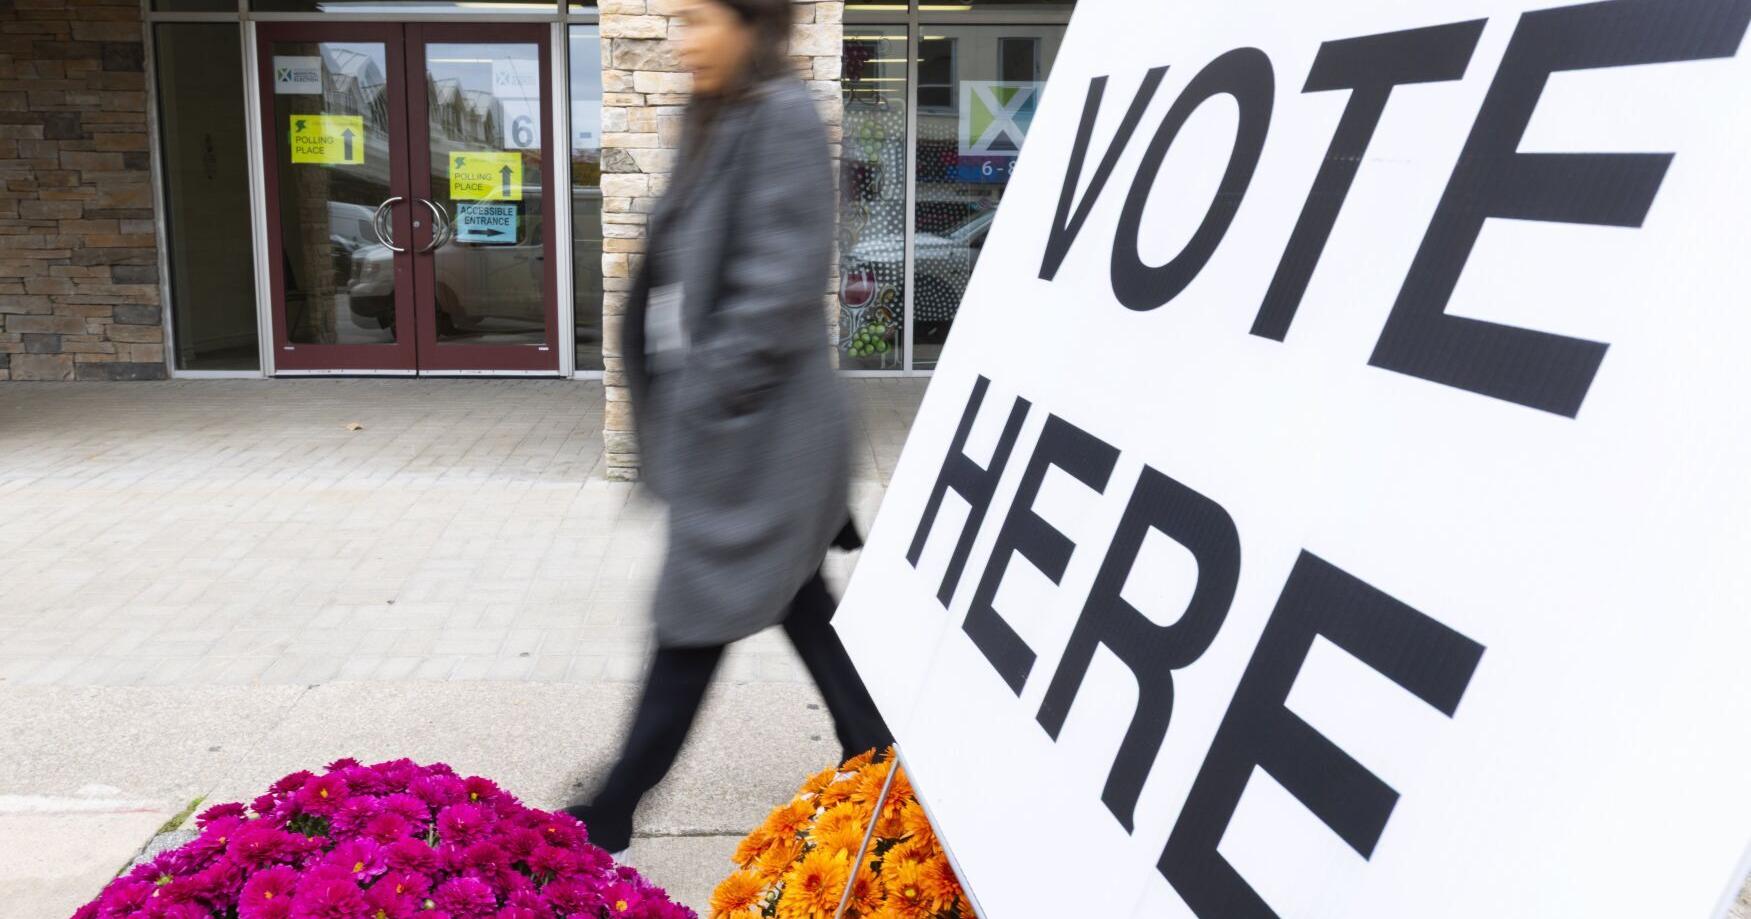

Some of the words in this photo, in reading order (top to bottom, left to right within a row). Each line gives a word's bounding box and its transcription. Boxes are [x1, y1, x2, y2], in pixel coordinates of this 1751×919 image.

[511, 115, 533, 148] 6
[295, 135, 335, 144] POLLING
[295, 146, 325, 155] PLACE
[982, 161, 993, 176] 6
[454, 172, 493, 181] POLLING
[454, 182, 484, 191] PLACE
[460, 206, 513, 217] ACCESSIBLE
[1038, 0, 1751, 419] VOTE
[464, 215, 510, 226] ENTRANCE
[906, 373, 1487, 919] HERE
